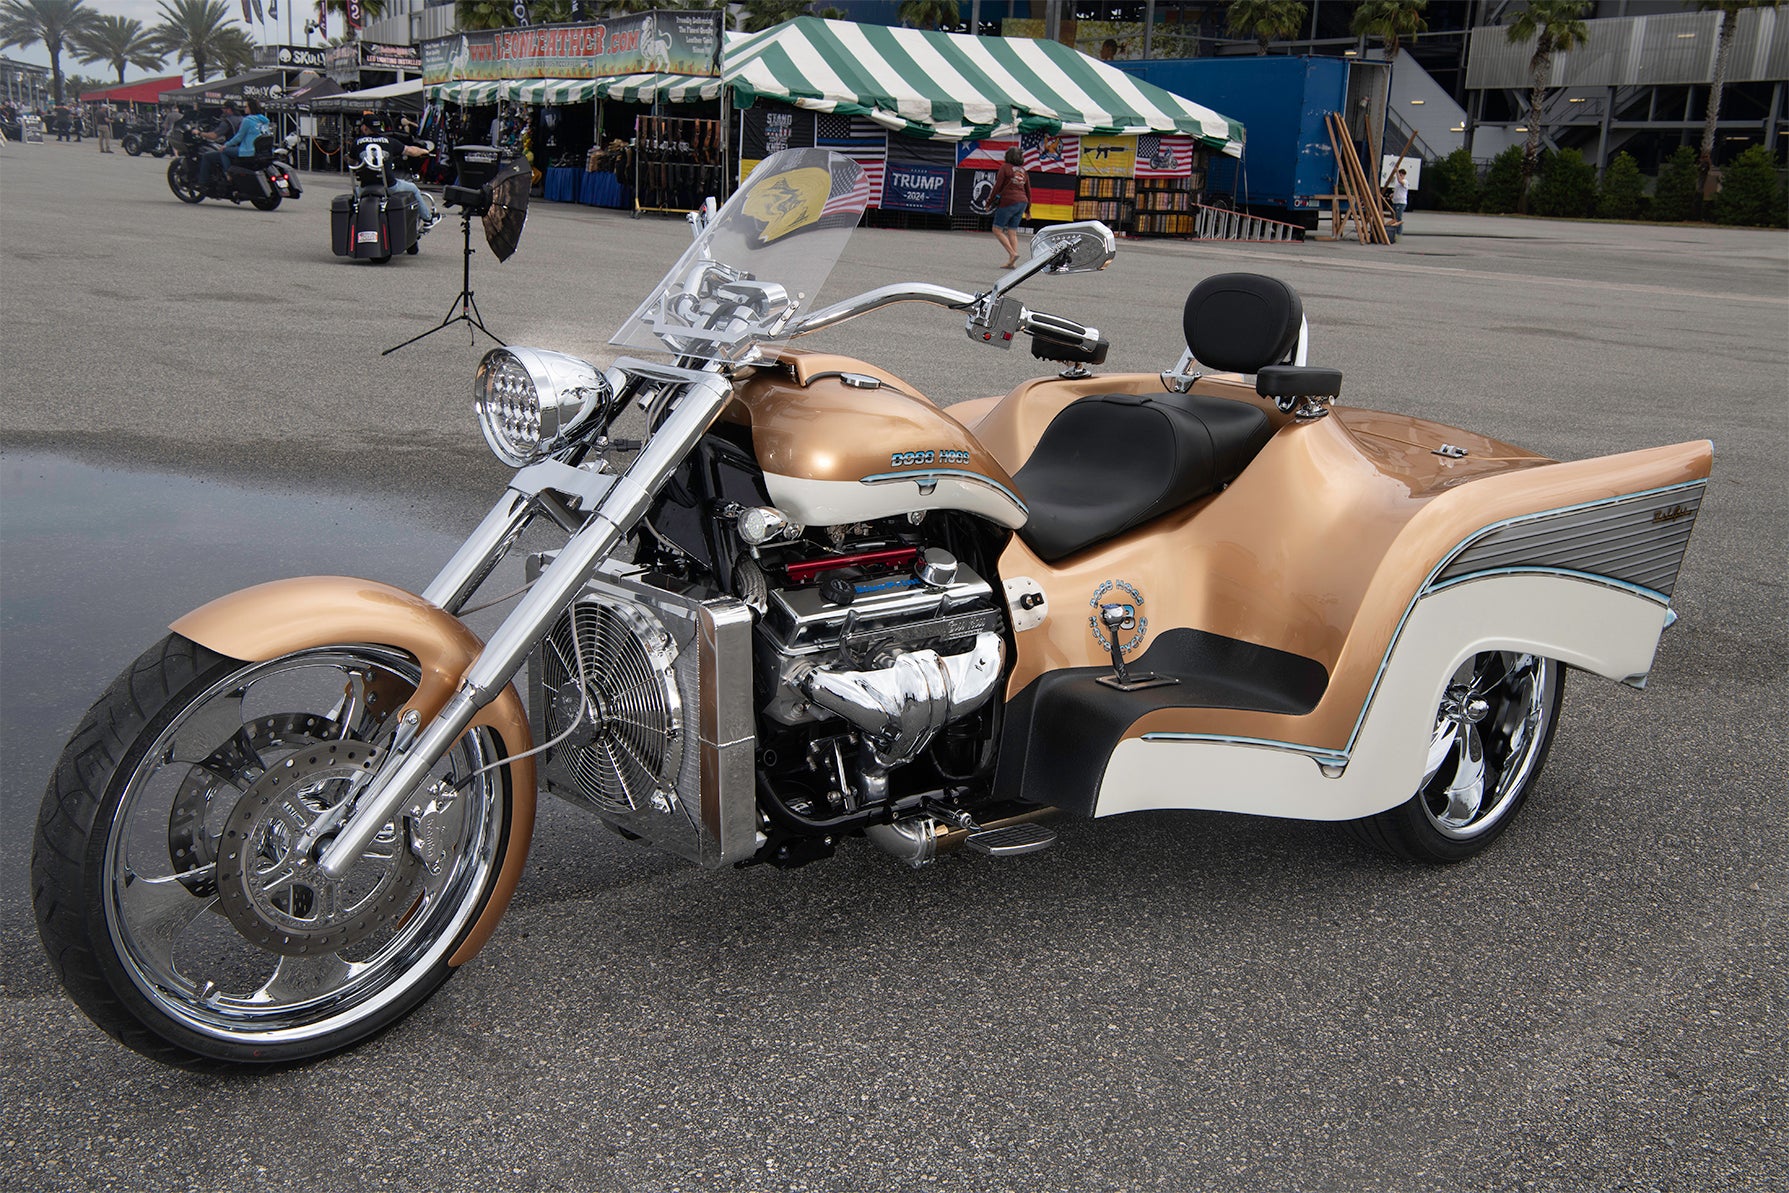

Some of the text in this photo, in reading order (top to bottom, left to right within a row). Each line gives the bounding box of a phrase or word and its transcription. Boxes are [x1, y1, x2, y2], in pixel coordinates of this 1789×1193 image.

[766, 113, 793, 126] STAND
[892, 172, 944, 191] TRUMP
[891, 449, 970, 467] BOSS HOSS
[1089, 579, 1145, 609] BOSS HOSS
